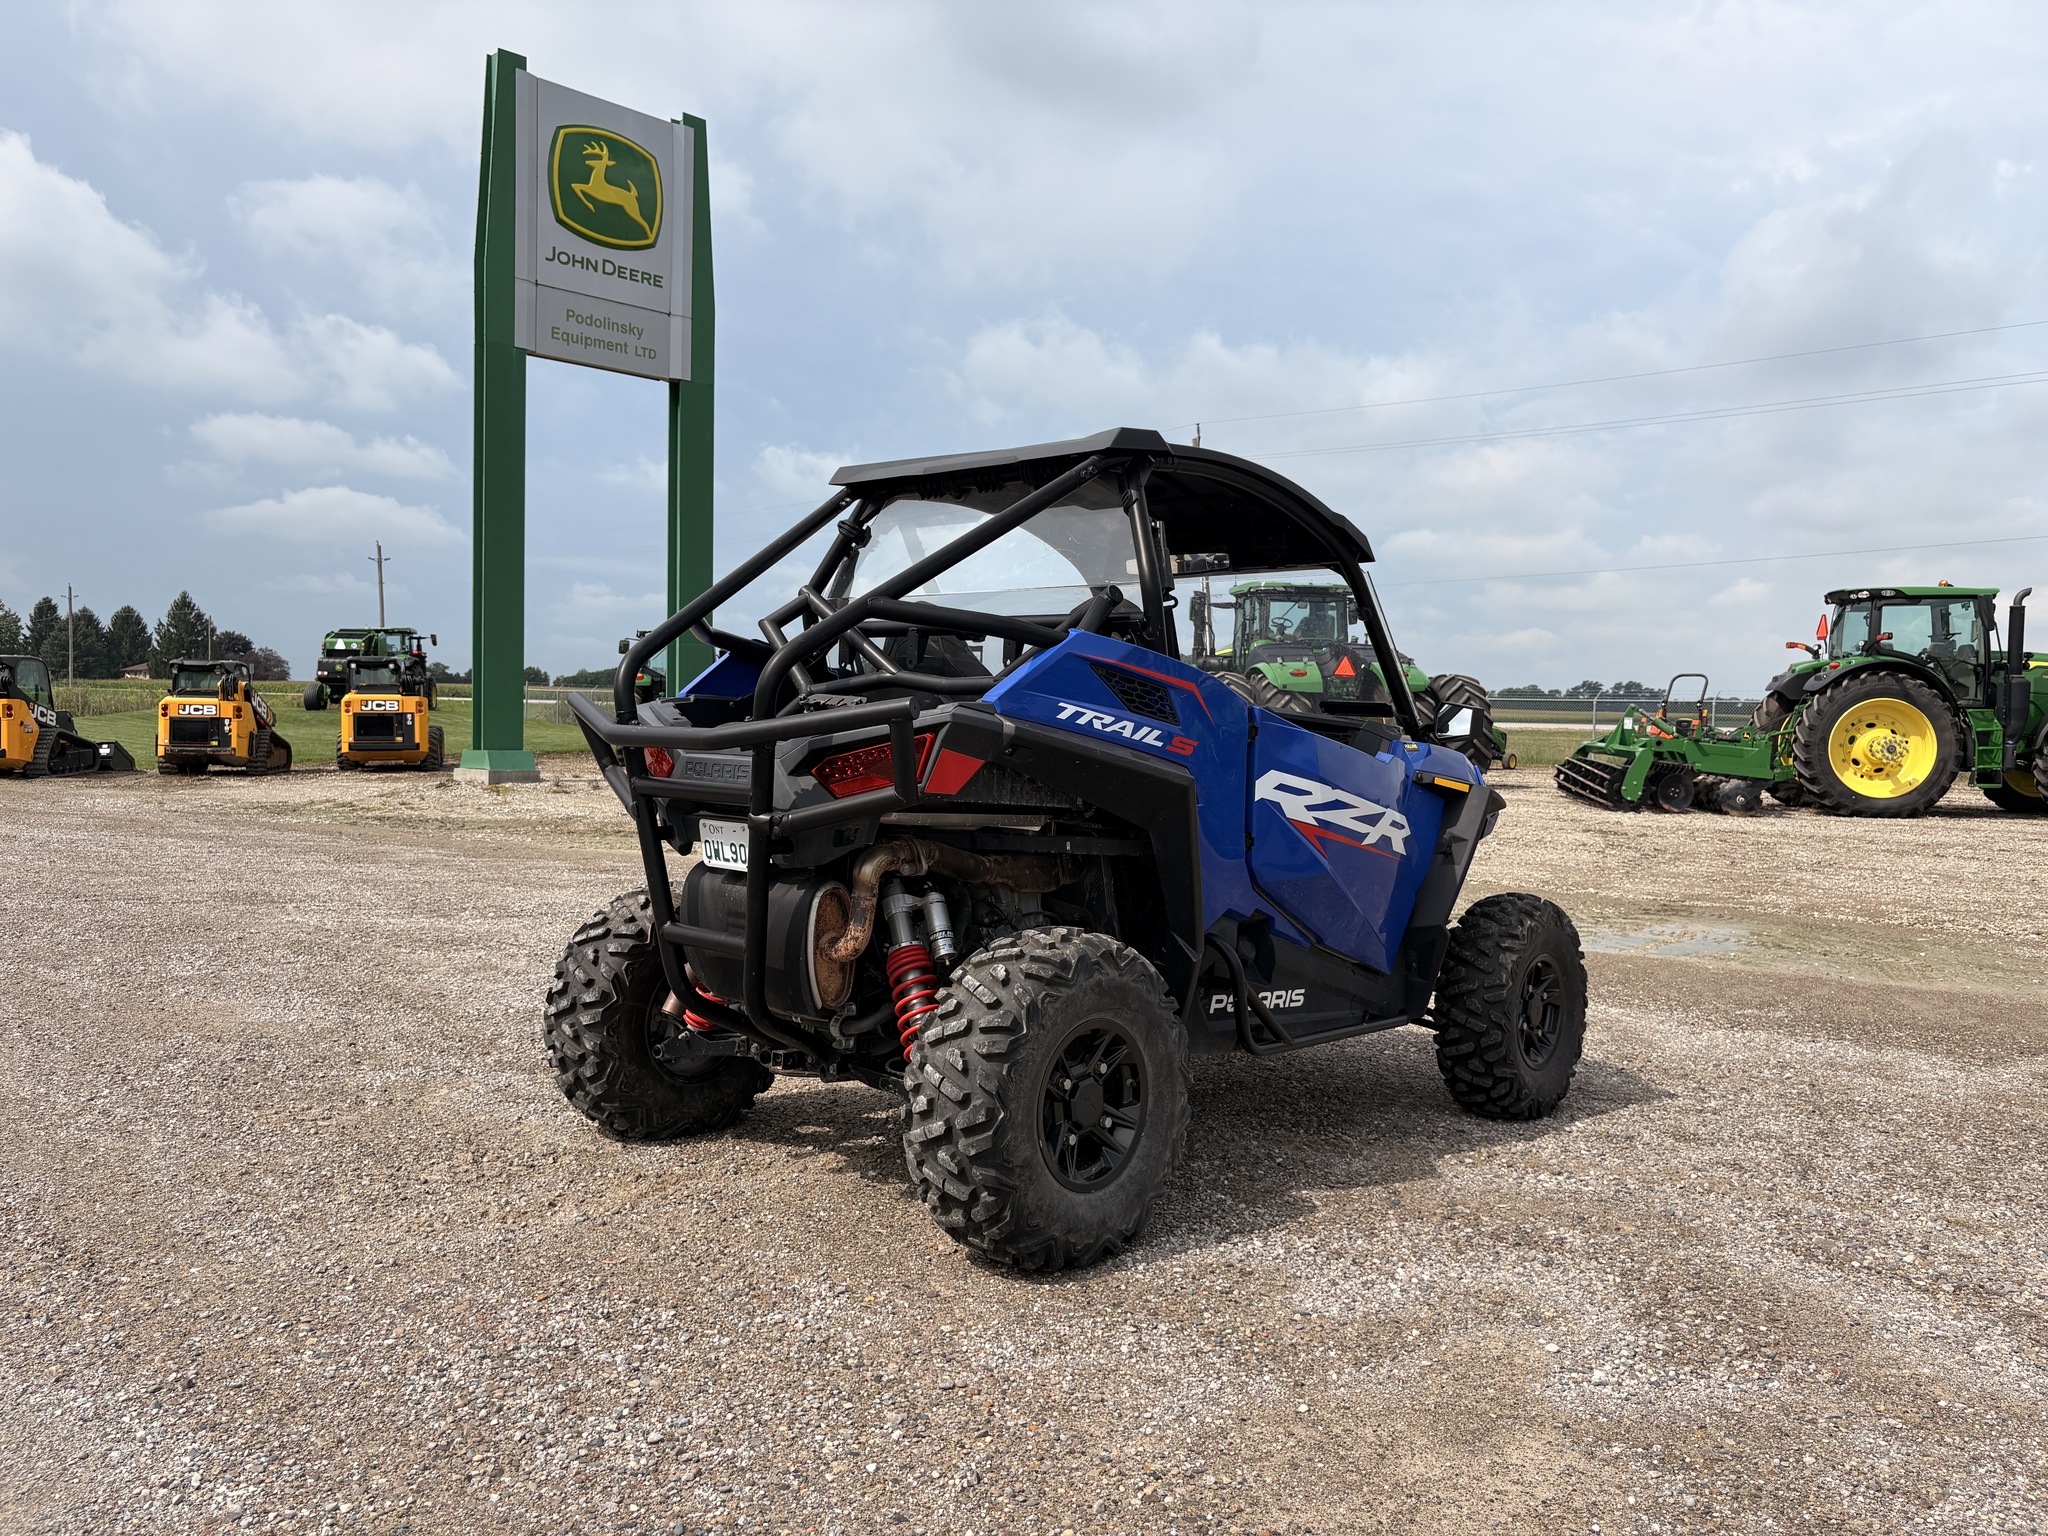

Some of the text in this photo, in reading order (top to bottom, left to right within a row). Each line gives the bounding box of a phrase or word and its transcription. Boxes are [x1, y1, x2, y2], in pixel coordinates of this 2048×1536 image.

[545, 246, 664, 289] JOHN DEERE
[565, 308, 644, 341] Podolinsky
[550, 325, 657, 360] Equipment LTD
[30, 703, 57, 727] JCB
[178, 704, 217, 715] JCB
[251, 693, 267, 720] JCB
[361, 700, 399, 711] JCB
[1056, 702, 1199, 756] TRAIL S
[685, 761, 751, 780] POLARIS
[1254, 769, 1411, 855] RZR
[1209, 988, 1305, 1014] PARIS
